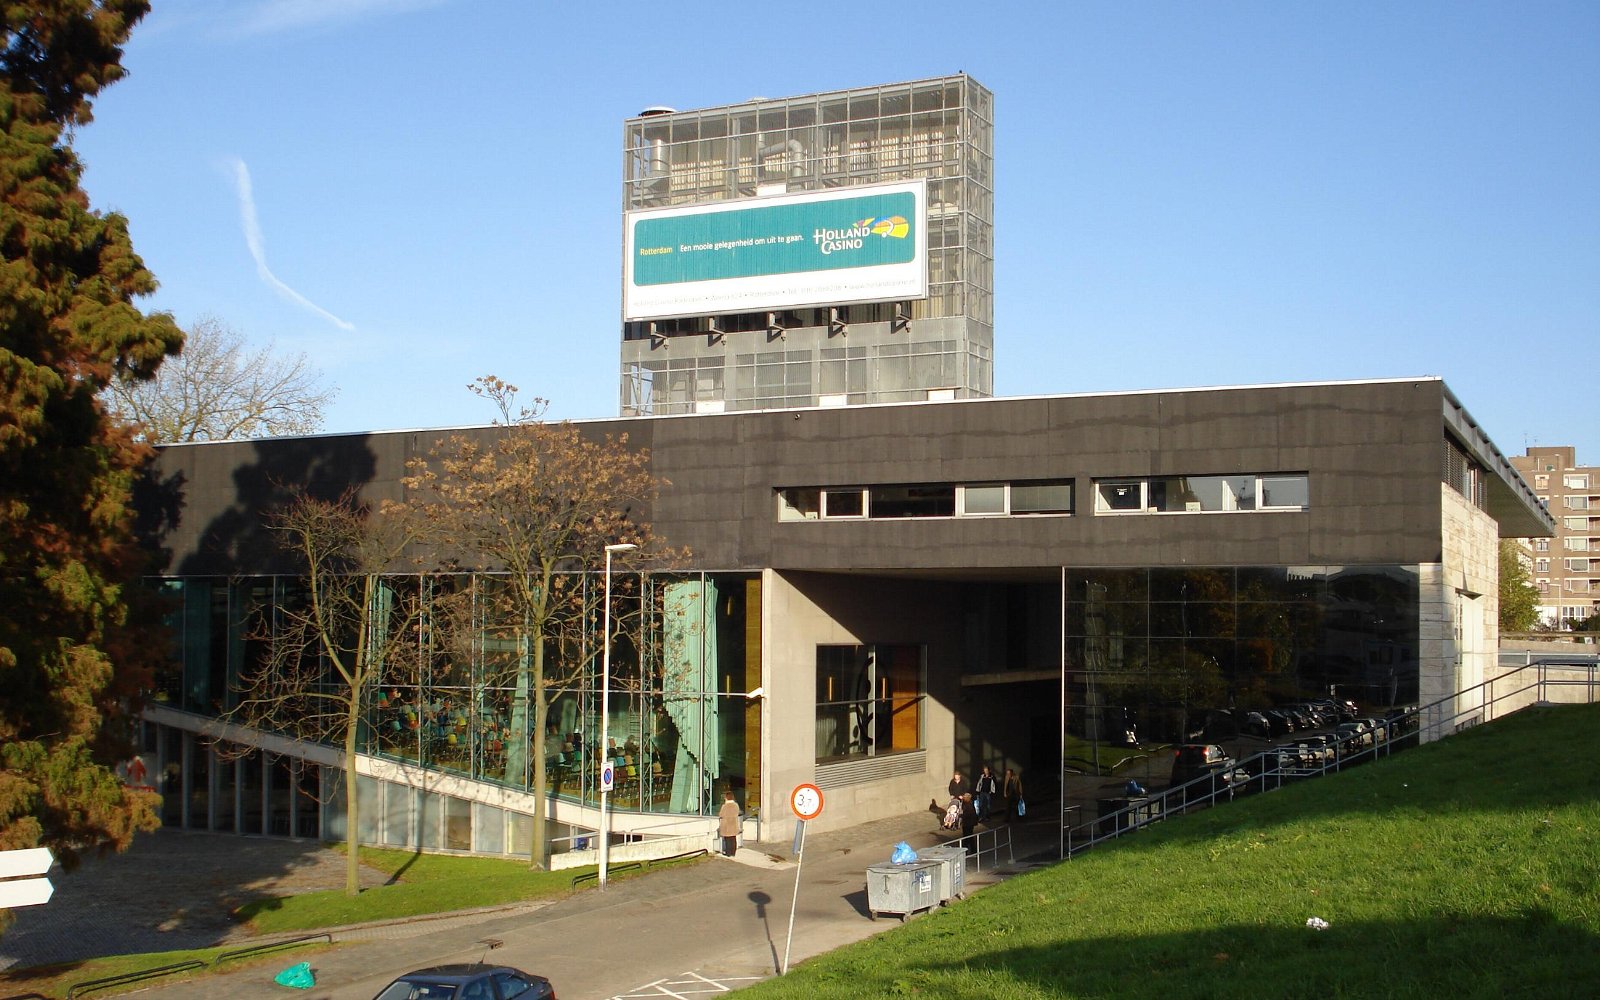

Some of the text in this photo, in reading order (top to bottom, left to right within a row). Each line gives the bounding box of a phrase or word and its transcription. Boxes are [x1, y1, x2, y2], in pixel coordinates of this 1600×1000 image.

[813, 226, 871, 244] HOLLAND
[640, 247, 673, 256] Rotterdam
[680, 244, 692, 252] Een
[693, 242, 713, 251] mooie
[714, 238, 753, 250] gelegenheid
[767, 236, 776, 244] uit
[821, 239, 863, 255] CASINO
